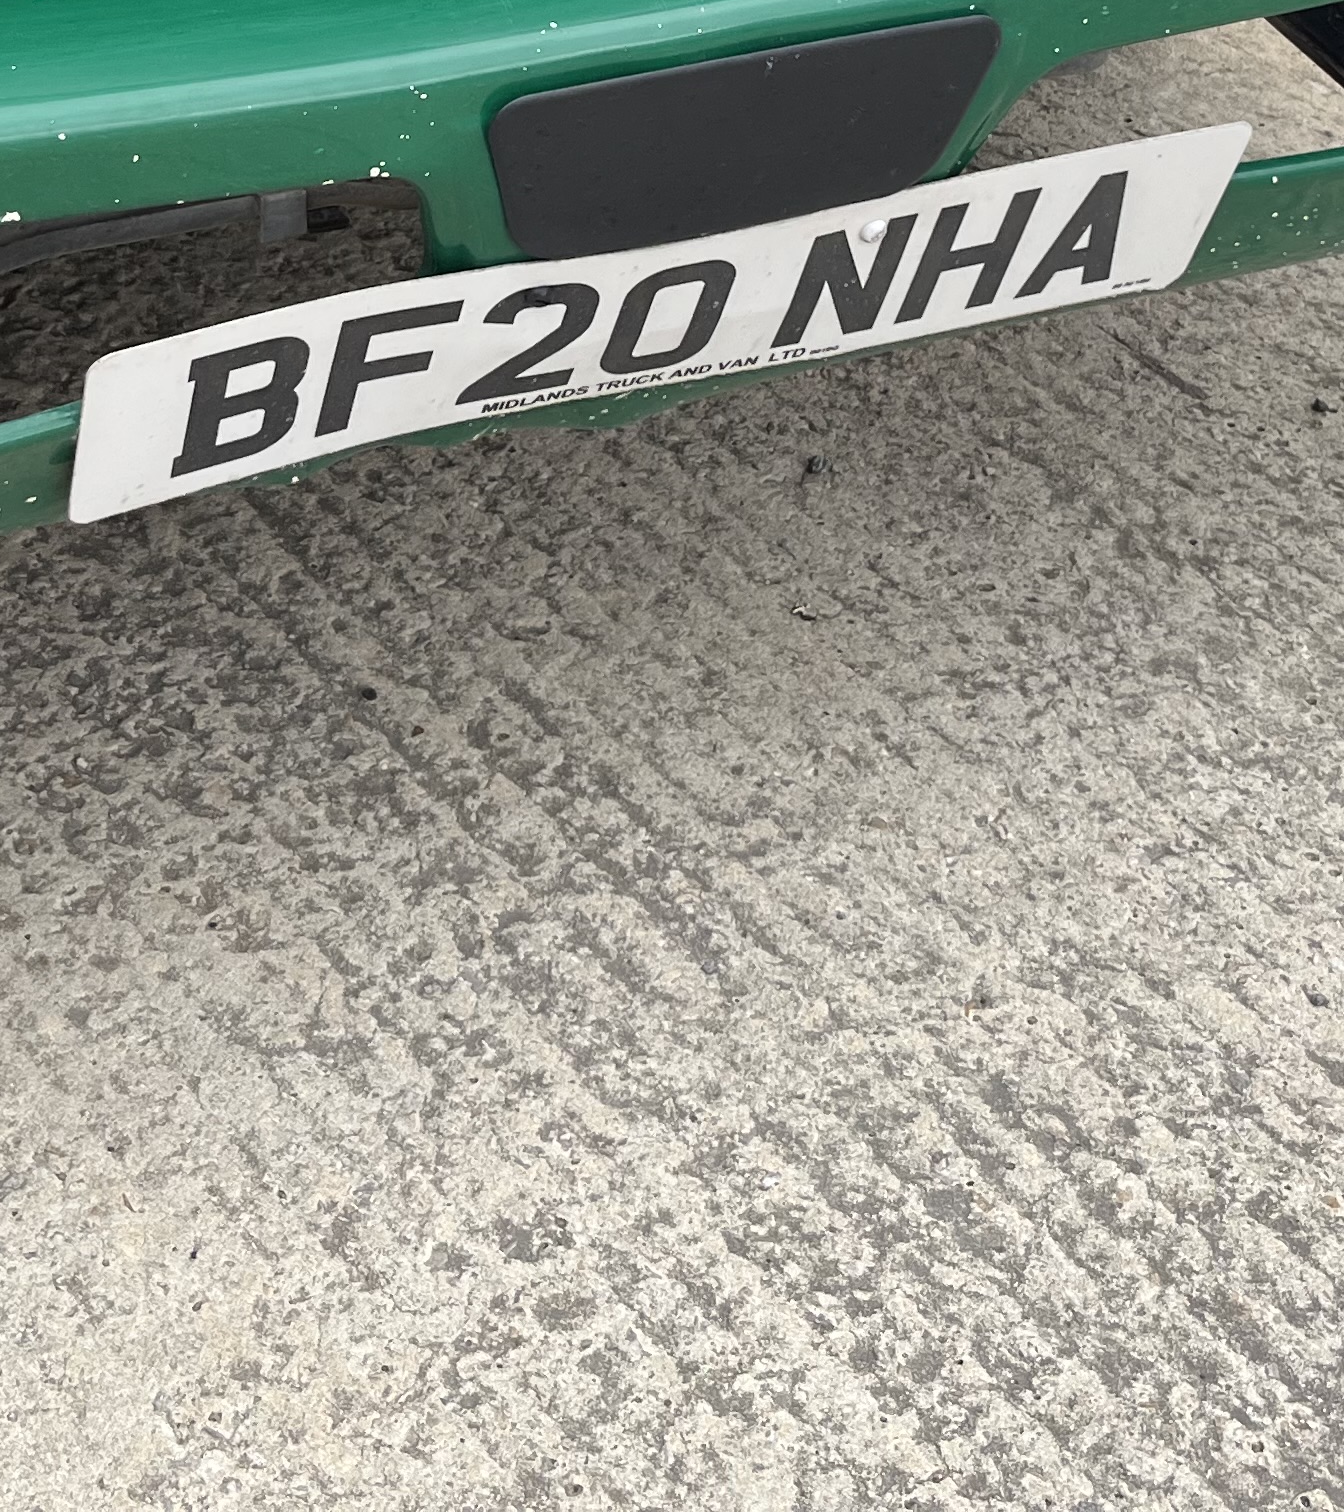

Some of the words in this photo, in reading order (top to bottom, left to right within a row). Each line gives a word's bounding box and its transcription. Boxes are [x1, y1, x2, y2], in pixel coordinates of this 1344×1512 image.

[171, 258, 737, 479] BF20
[770, 170, 1129, 349] NHA
[480, 385, 589, 414] MIDLANDS
[596, 371, 664, 393] TRUCK
[667, 363, 713, 381] AND
[718, 354, 760, 371] VAN
[767, 346, 807, 363] LTD
